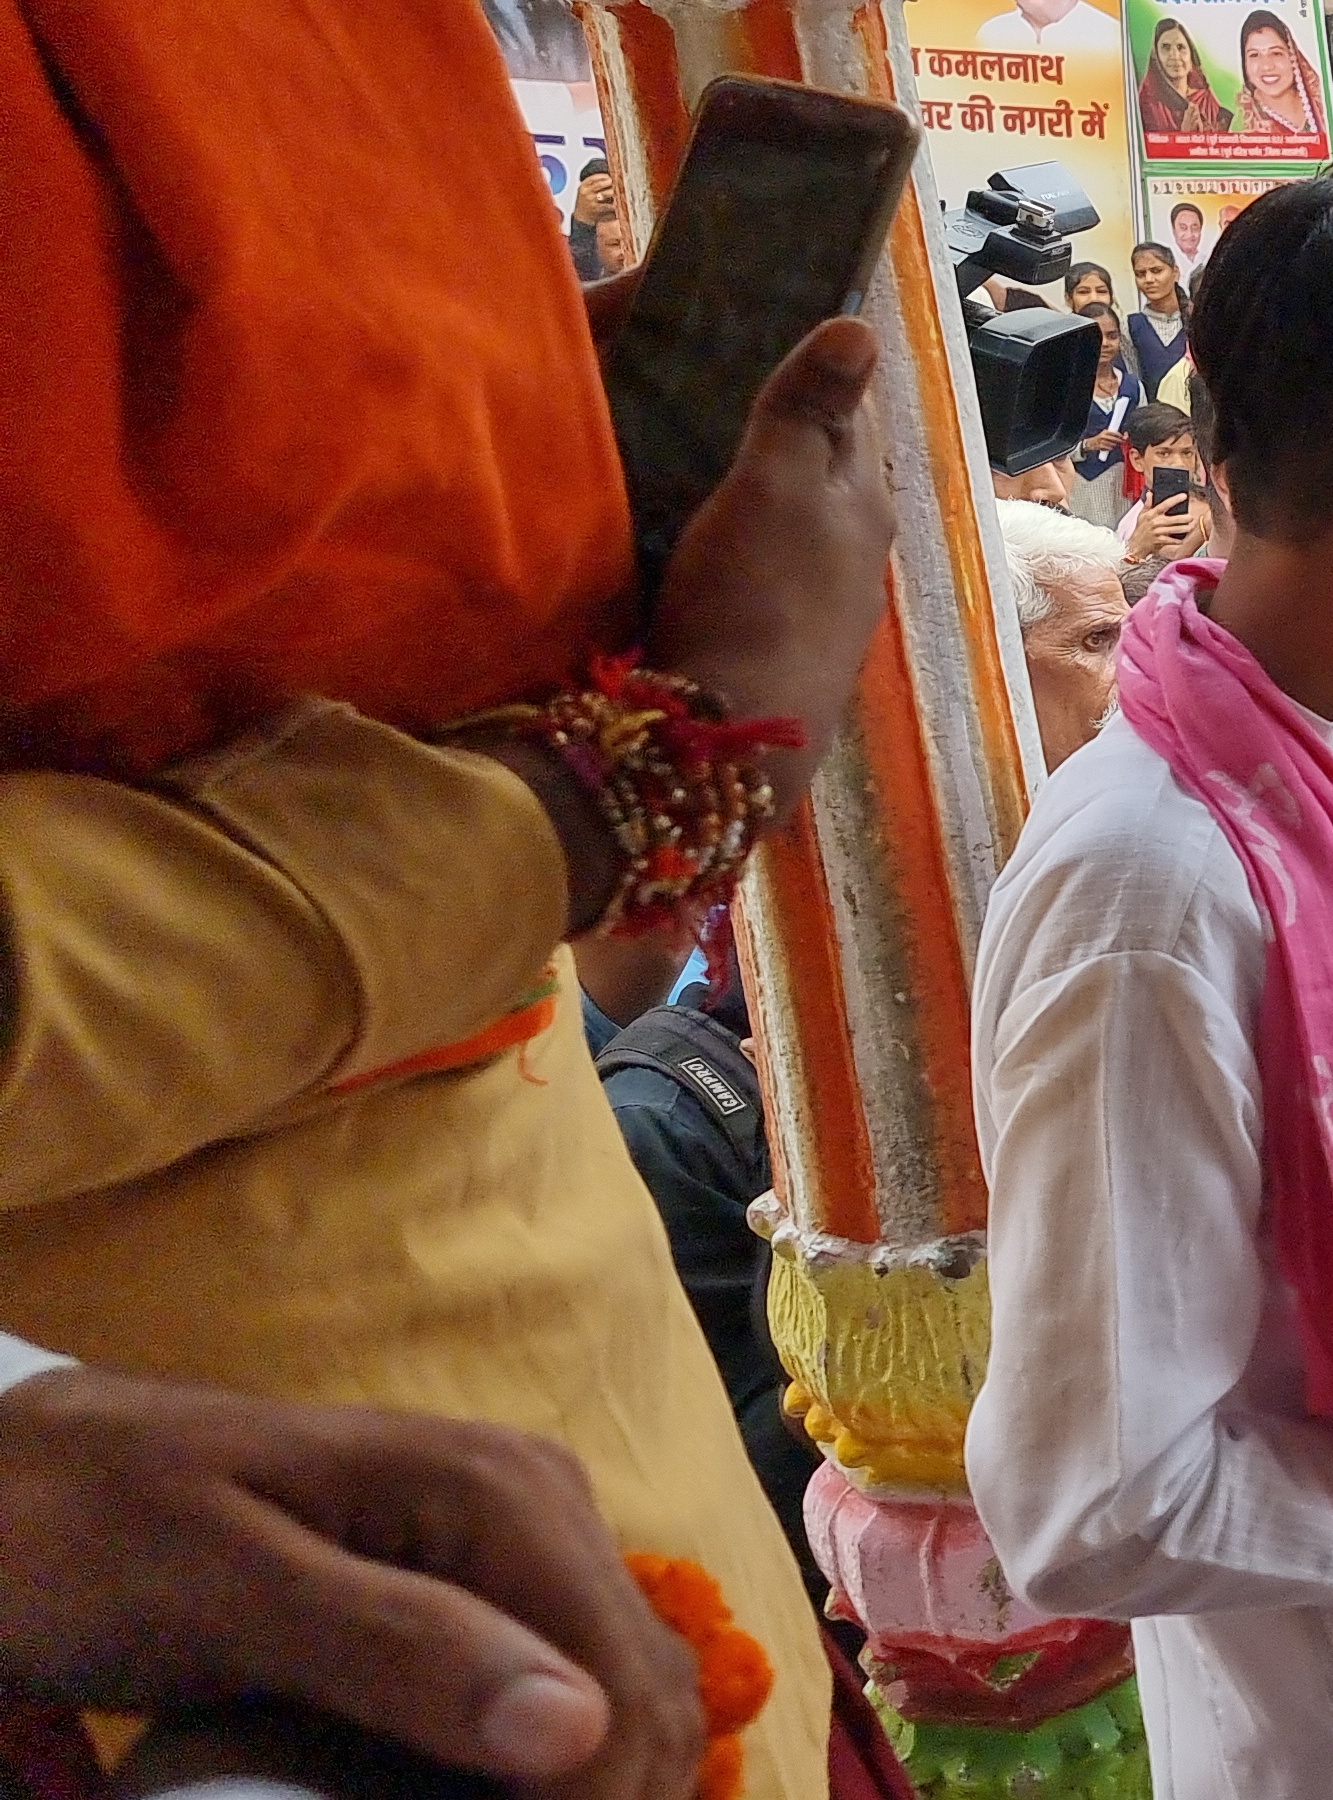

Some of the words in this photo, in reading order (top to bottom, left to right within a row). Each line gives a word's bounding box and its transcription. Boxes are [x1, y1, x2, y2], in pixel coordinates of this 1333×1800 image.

[925, 48, 1064, 85] कमलनाथ
[957, 95, 995, 133] की
[1000, 100, 1074, 138] नगरी
[1078, 101, 1110, 140] में
[688, 1063, 738, 1107] CAMPRO
